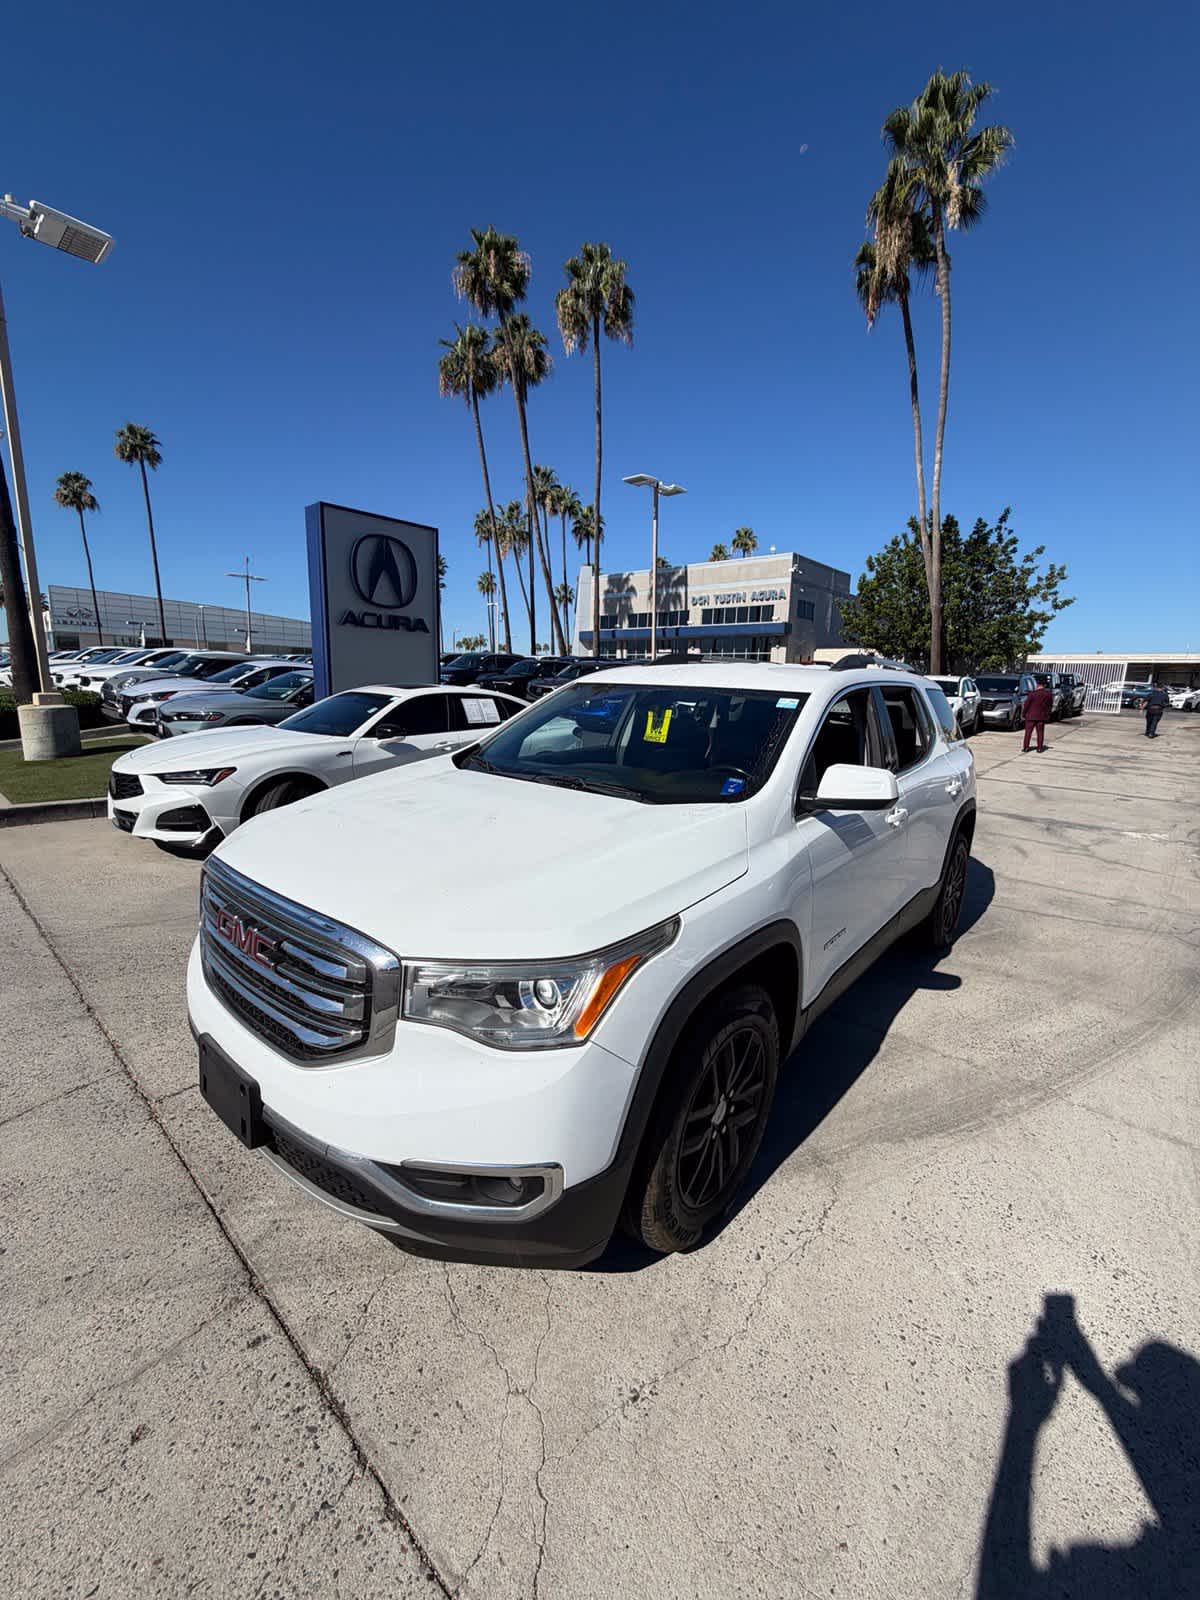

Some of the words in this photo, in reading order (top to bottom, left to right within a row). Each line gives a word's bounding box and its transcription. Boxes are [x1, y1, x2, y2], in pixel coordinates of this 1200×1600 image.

[713, 591, 747, 605] TUSTIN
[751, 588, 787, 602] ACURA
[337, 608, 431, 634] ACURA
[217, 909, 276, 969] GMC
